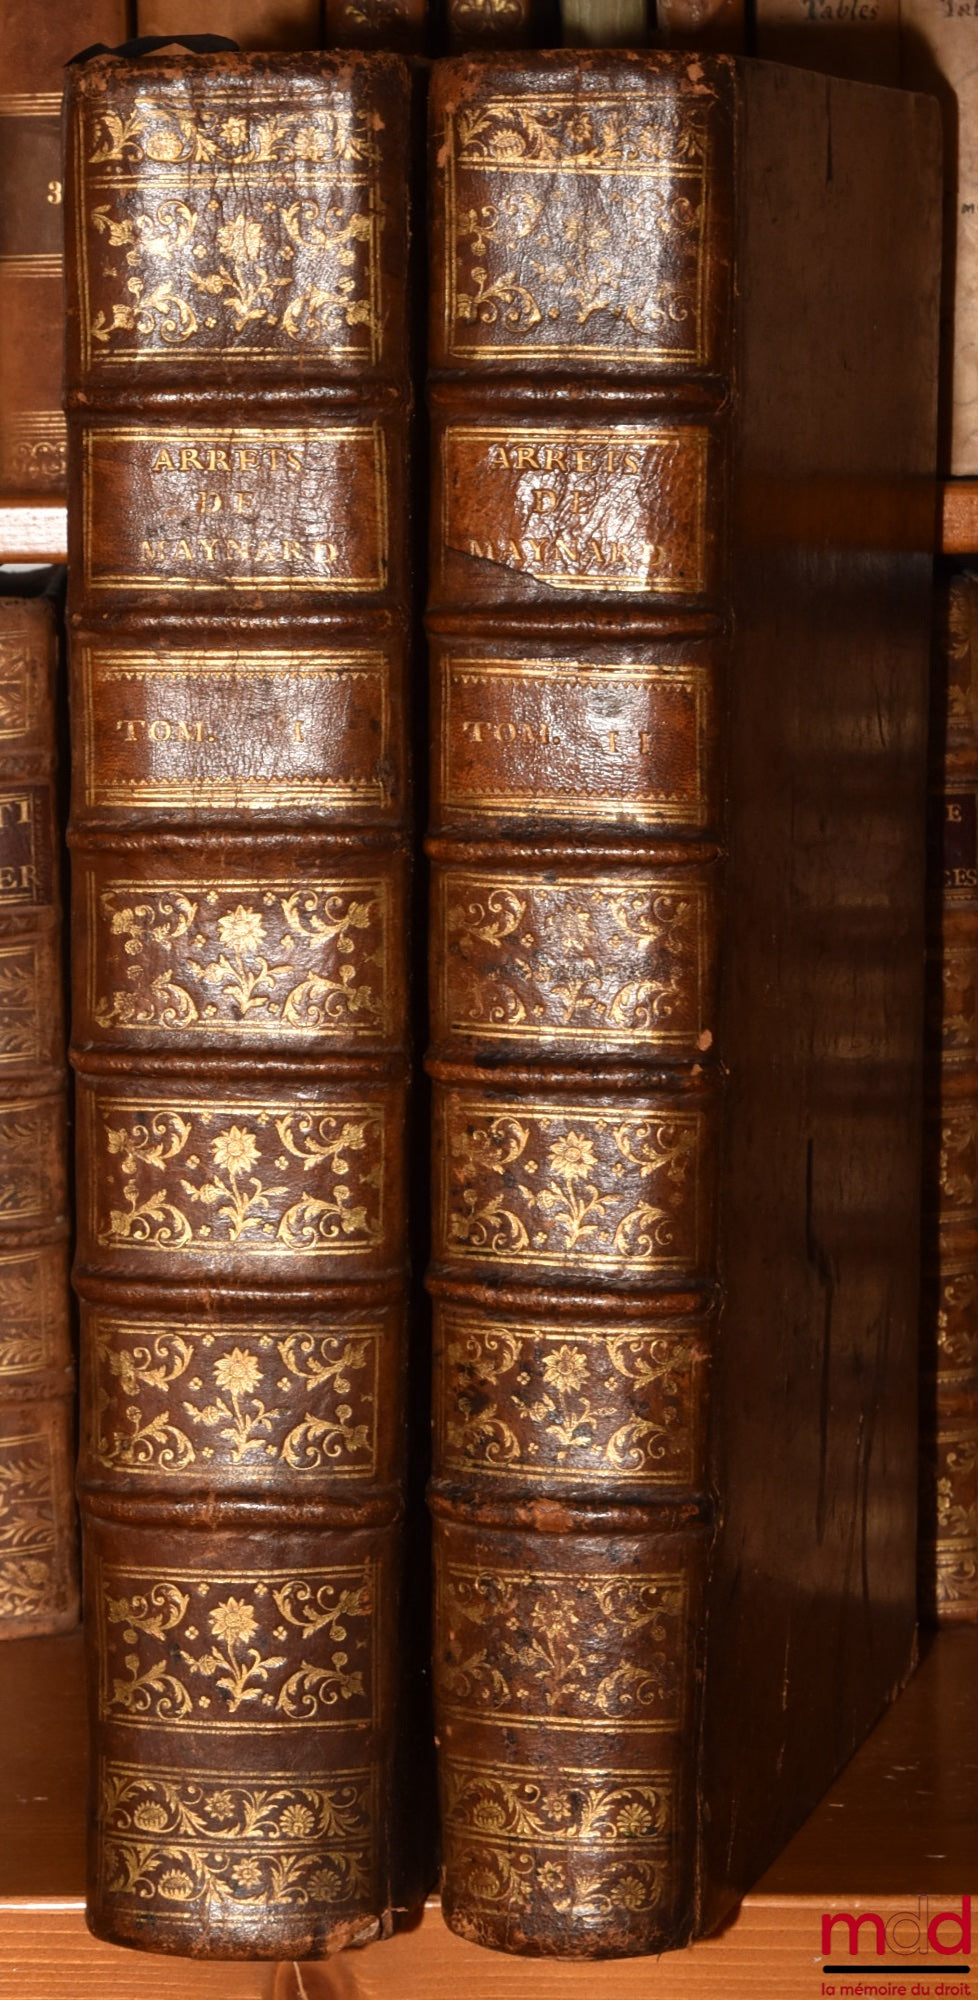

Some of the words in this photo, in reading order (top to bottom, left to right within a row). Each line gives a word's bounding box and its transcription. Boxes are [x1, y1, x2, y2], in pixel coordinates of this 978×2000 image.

[47, 181, 62, 204] 3
[152, 447, 304, 472] ARRETS
[491, 447, 641, 475] ARRETS
[198, 490, 257, 516] DE
[532, 489, 592, 516] DE
[139, 538, 339, 565] MAYNARD
[469, 539, 664, 567] MAYNARD
[117, 720, 216, 743] TOM.
[463, 721, 561, 744] TOM.
